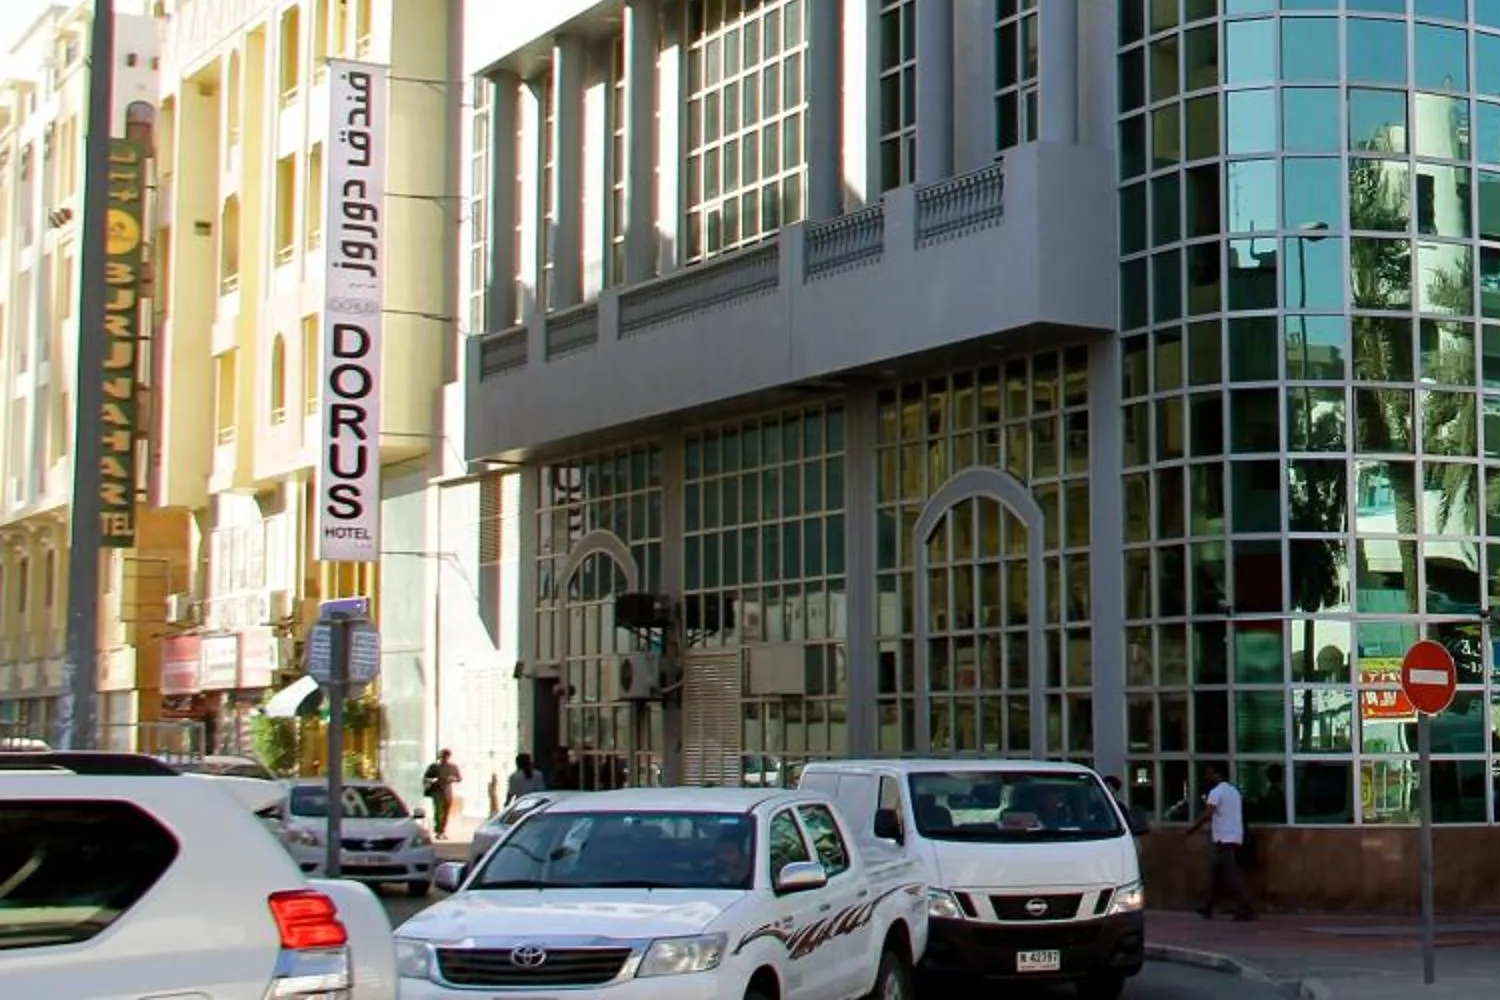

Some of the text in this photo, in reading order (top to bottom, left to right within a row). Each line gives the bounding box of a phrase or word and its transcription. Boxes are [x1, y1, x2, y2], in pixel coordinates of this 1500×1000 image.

[339, 71, 371, 167] فندق
[332, 179, 378, 278] دوروز
[327, 323, 374, 521] DORUS
[100, 511, 134, 537] TEL
[325, 526, 372, 541] HOTEL
